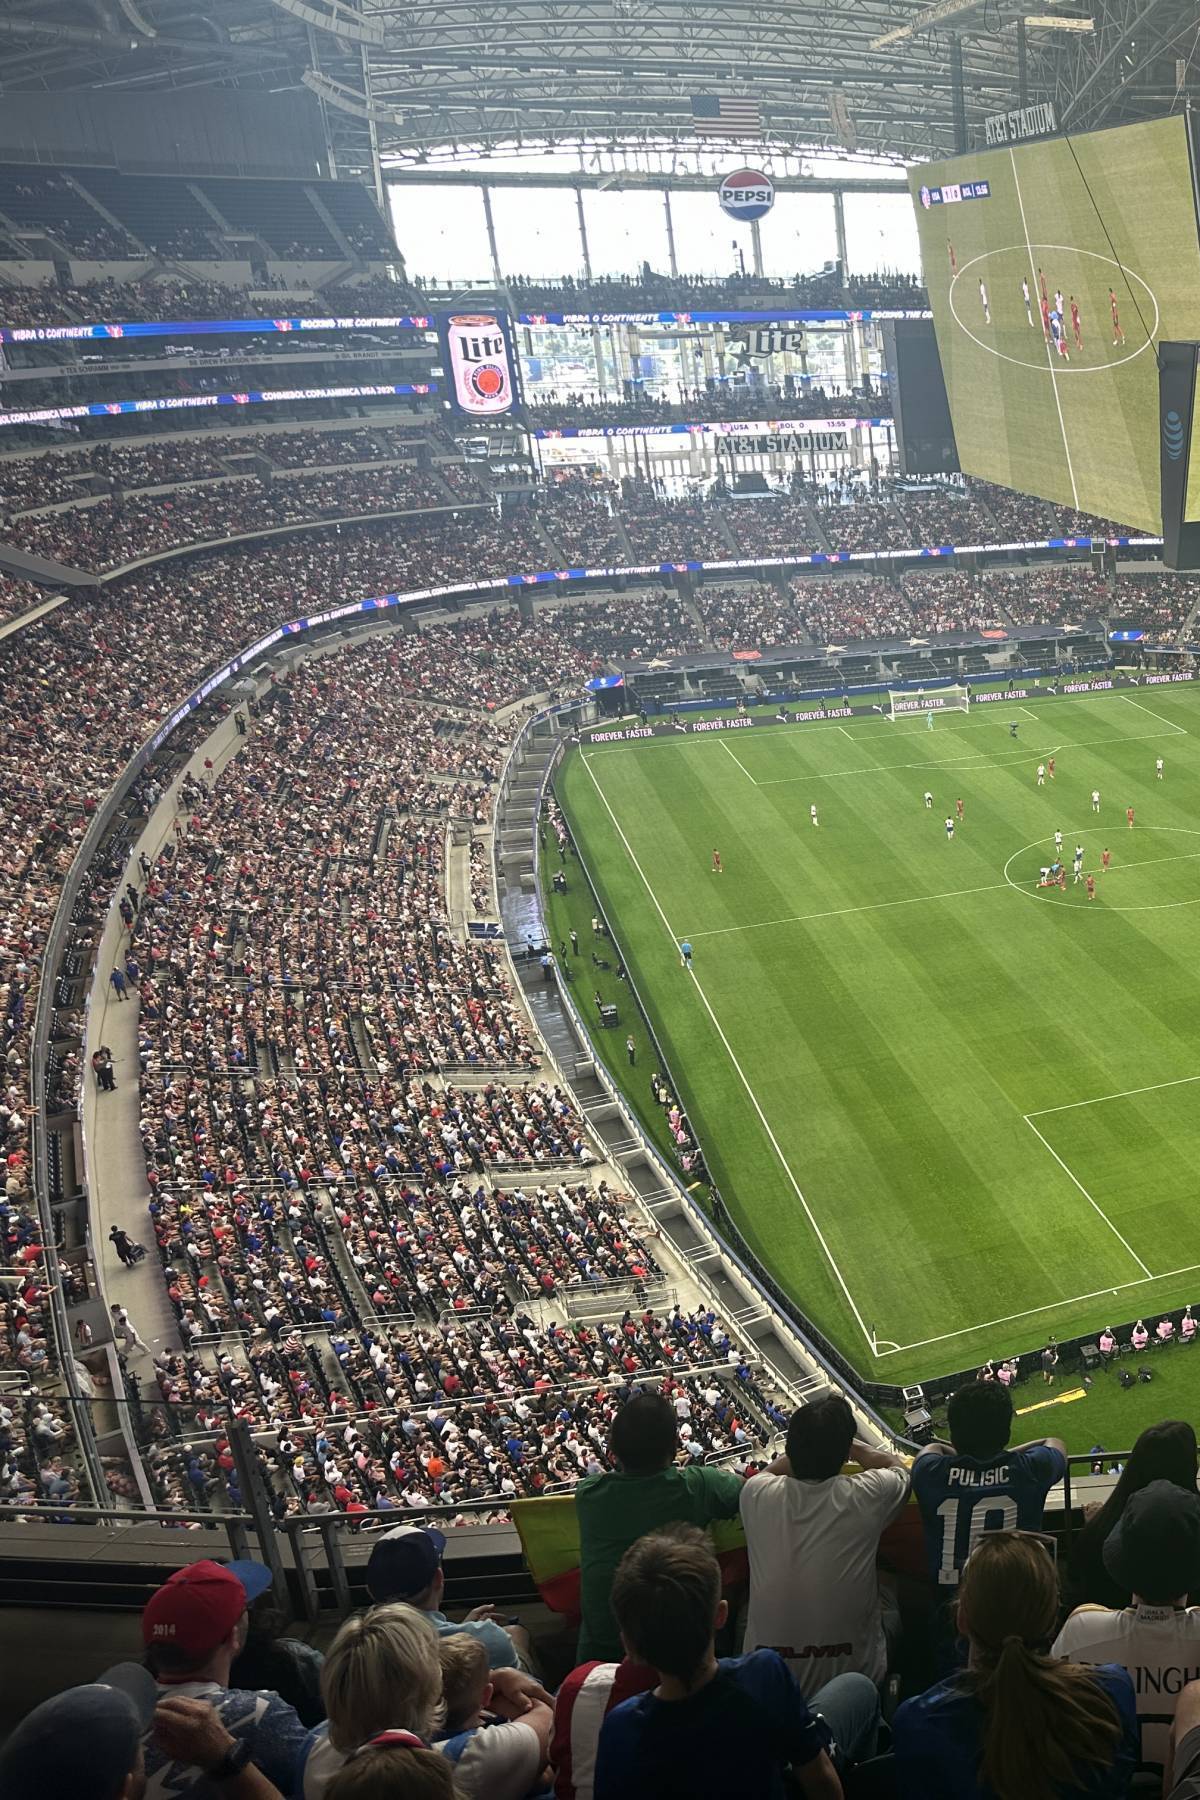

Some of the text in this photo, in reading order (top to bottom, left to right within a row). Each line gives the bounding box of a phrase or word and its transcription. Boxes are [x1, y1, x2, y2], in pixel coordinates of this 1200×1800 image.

[985, 102, 1056, 144] AT&T STADIUM
[722, 190, 771, 202] PEPSI
[301, 317, 402, 328] ROCKING THE CONTINENT
[562, 315, 590, 323] VIBRA
[602, 313, 659, 323] CONTINENTE
[12, 326, 93, 341] VIBRA O CONTINENTE
[458, 335, 503, 363] Lite
[747, 330, 803, 358] Lite
[262, 391, 305, 401] CONMEBOL
[323, 387, 360, 398] AMERICA
[361, 386, 376, 396] USA
[136, 396, 218, 411] VIBRA O CONTINENTE
[578, 426, 672, 436] VIBRA O CONTINENTE
[780, 422, 795, 430] BOL
[715, 432, 848, 454] AT&T STADIUM
[1146, 672, 1193, 684] FOREVER. FASTER.
[1064, 680, 1113, 693] FOREVER. FASTER.
[976, 690, 1028, 702] FOREVER. FASTER.
[921, 698, 946, 709] FASTER.
[796, 708, 854, 721] FOREVER. FASTER.
[693, 718, 753, 732] FOREVER. FASTER.
[591, 728, 655, 742] FOREVER. FASTER.
[948, 1465, 1010, 1487] PULISIC
[152, 1623, 176, 1636] 2014
